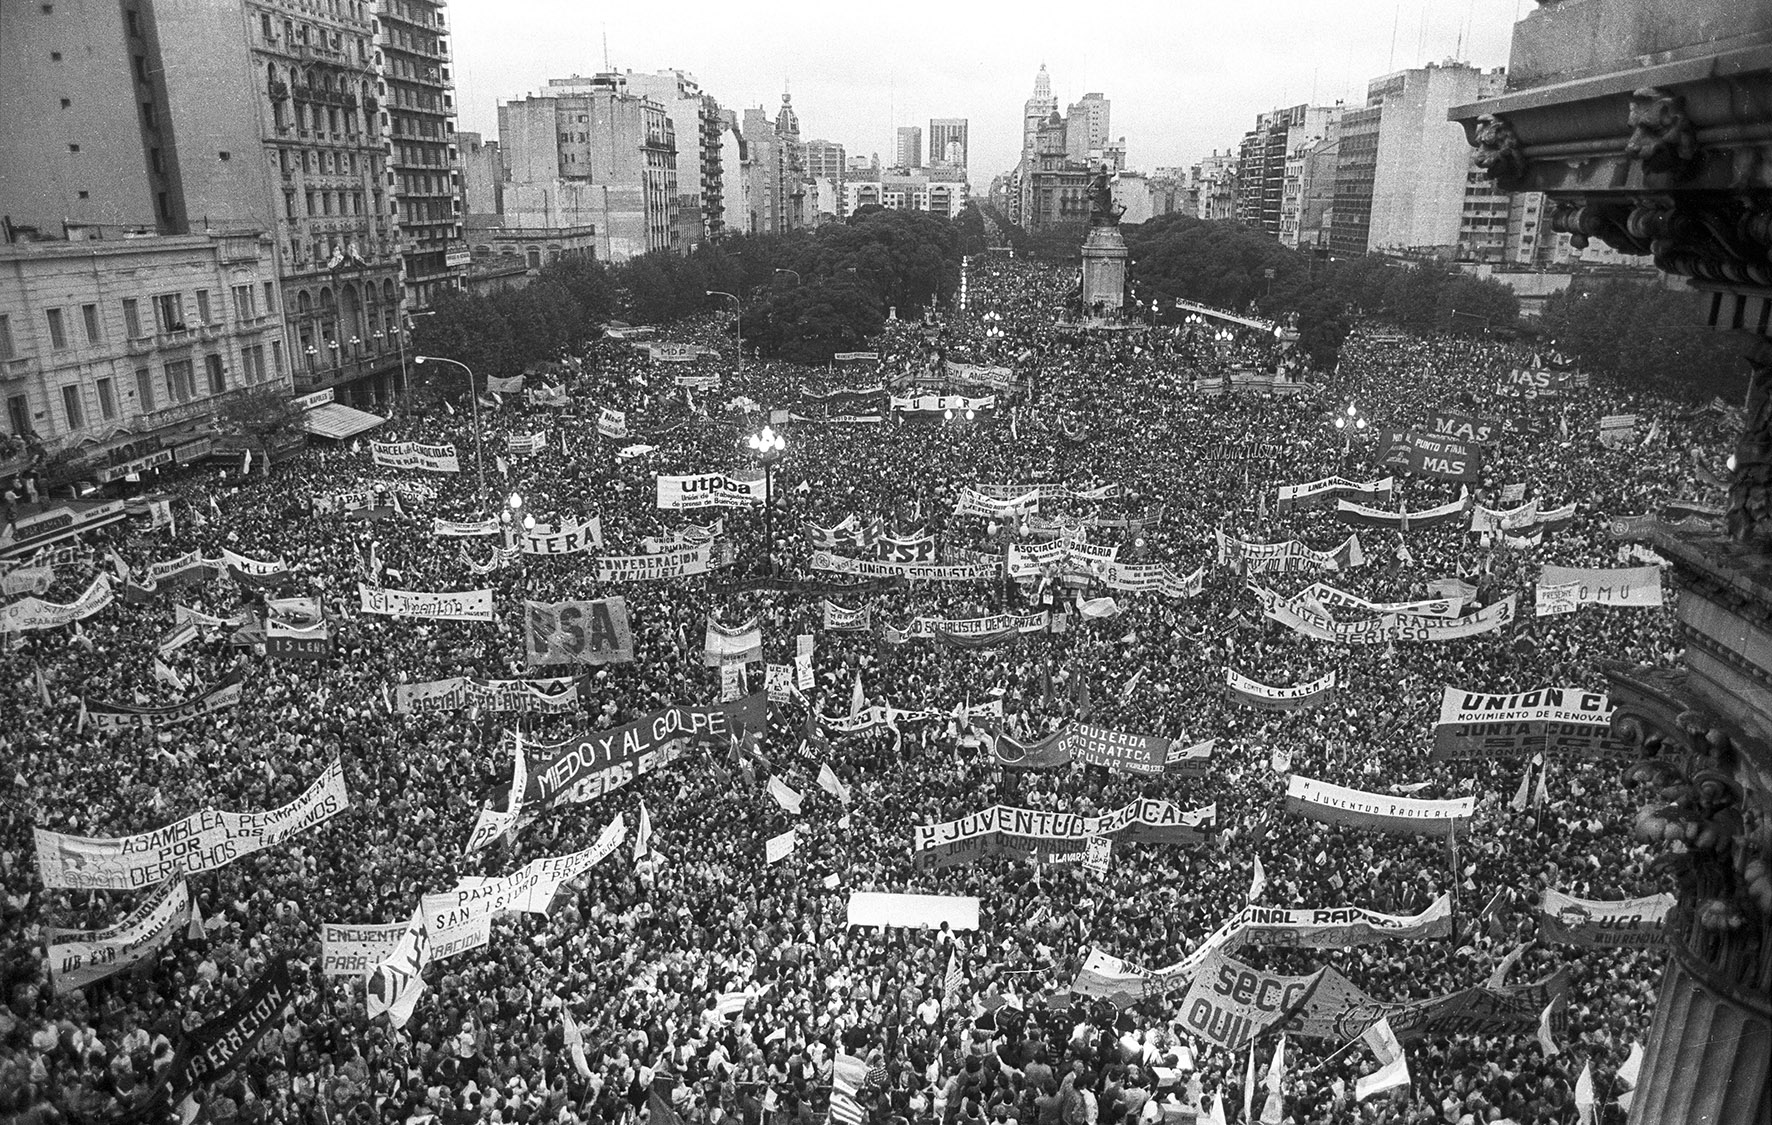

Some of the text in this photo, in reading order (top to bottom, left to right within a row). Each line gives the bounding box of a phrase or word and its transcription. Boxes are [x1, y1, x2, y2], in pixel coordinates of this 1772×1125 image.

[660, 348, 686, 356] MDP
[1435, 418, 1491, 442] MAS
[1415, 438, 1441, 452] PUNTO
[1445, 443, 1468, 456] FINAL
[1422, 456, 1466, 475] MAS
[682, 476, 751, 494] utpba
[878, 540, 933, 563] PSP
[1014, 540, 1112, 558] ASOCIACIO BANCARIA
[600, 551, 699, 570] CONFEDERACION
[610, 565, 685, 581] SOCIALISTA
[1396, 612, 1487, 629] RADICAL
[1335, 623, 1430, 645] BERISSO
[1461, 688, 1564, 712] UNION
[150, 700, 207, 725] BOCA
[1458, 711, 1529, 721] MOVIMIENTO
[1536, 710, 1550, 718] DE
[1064, 721, 1147, 748] IZQUIERDA
[1456, 722, 1531, 737] JUNTA
[537, 742, 596, 799] MIEDO
[599, 735, 614, 761] Y
[622, 727, 650, 757] AL
[652, 708, 727, 741] GOLPE
[1058, 734, 1152, 761] DEMOCRATICA
[1313, 792, 1449, 818] JUVENTUD RADICAL
[121, 810, 226, 855] ASAMBLEA
[226, 828, 265, 840] LOS
[942, 807, 1086, 839] JUVENTUD
[158, 837, 201, 860] POR
[995, 832, 1087, 854] COORDINADOR
[129, 843, 237, 888] DERECHOS
[435, 907, 470, 931] SAN
[1600, 914, 1642, 931] UCR
[326, 925, 405, 943] ENCUENTR
[185, 983, 283, 1087] IBERACION
